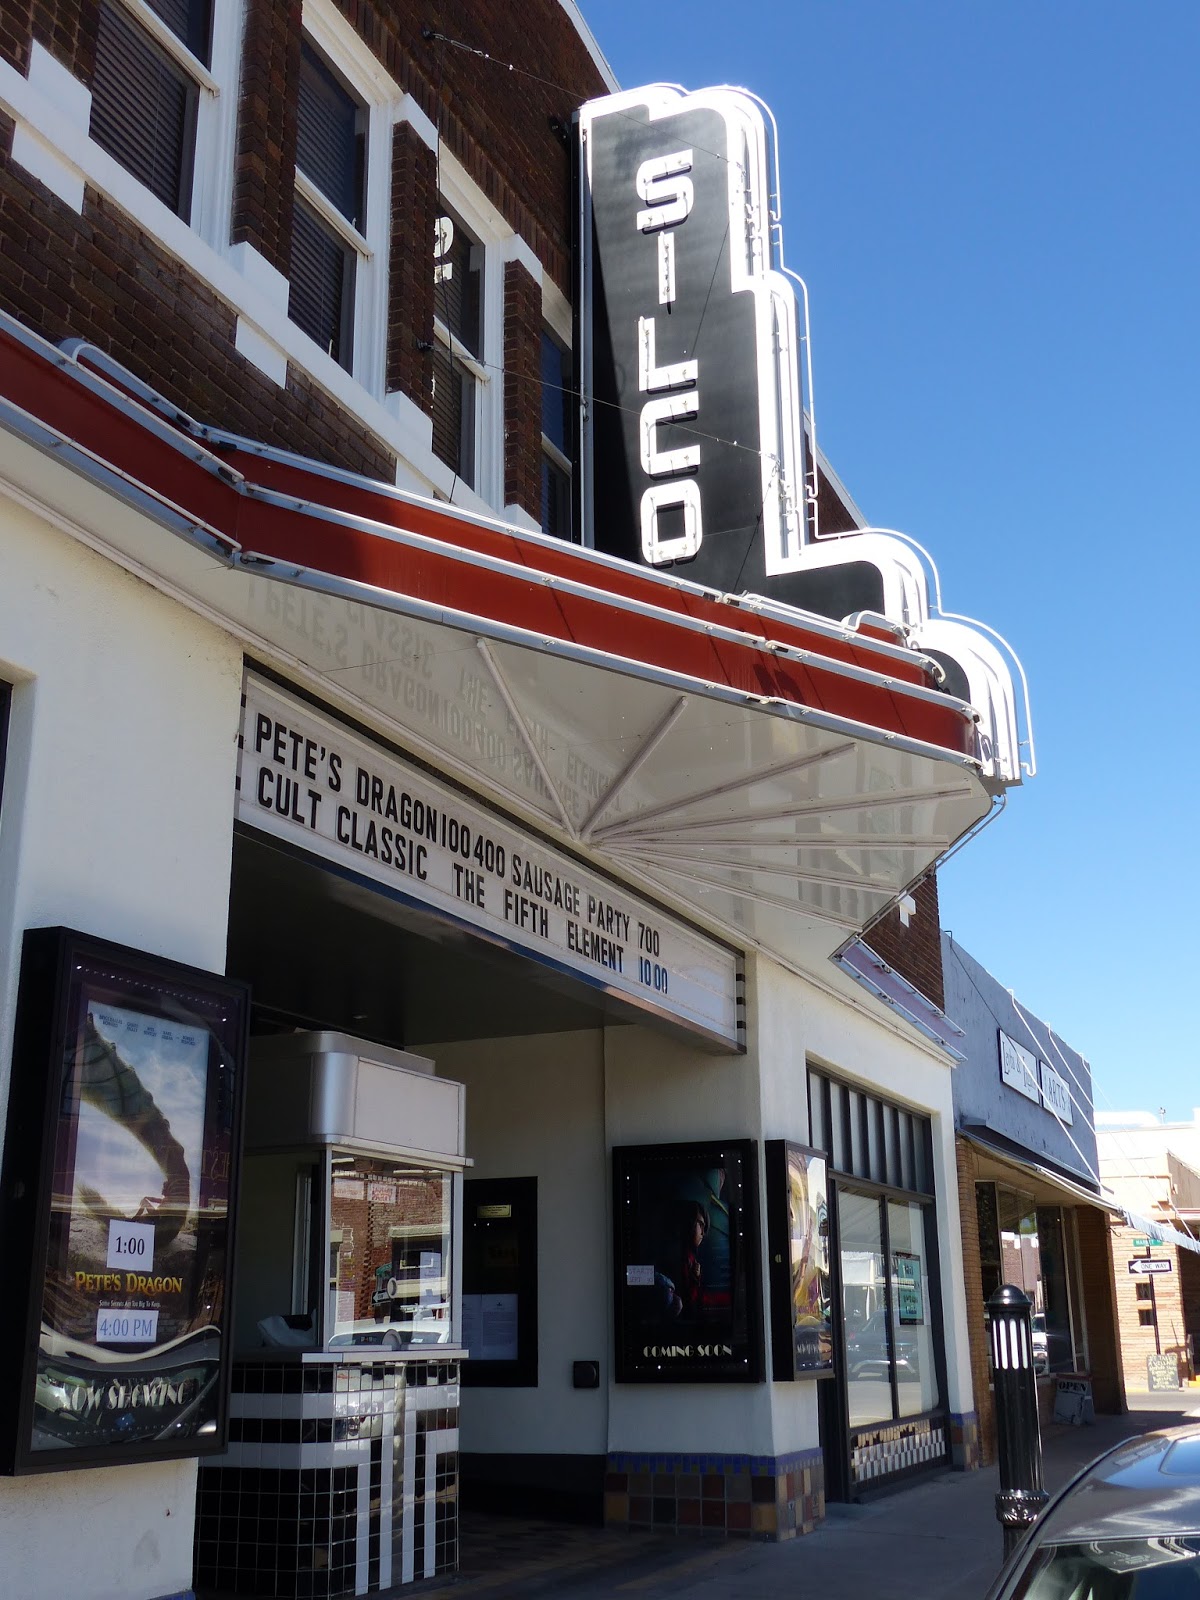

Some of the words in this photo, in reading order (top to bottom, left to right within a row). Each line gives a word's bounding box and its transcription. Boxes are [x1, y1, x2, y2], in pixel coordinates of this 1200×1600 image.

[636, 148, 703, 565] SILCO
[256, 712, 342, 792] PETE'S
[474, 834, 506, 878] 400
[512, 853, 580, 917] SAUSAGE
[588, 894, 630, 942] PARTY
[638, 921, 660, 957] 700
[257, 766, 322, 829] CULT
[337, 805, 428, 881] CLASSIC
[453, 862, 485, 909] THE
[504, 889, 549, 939] FIFTH
[567, 919, 624, 974] ELEMENT
[115, 1235, 146, 1256] 1:00
[75, 1271, 122, 1293] PETE'S
[126, 1272, 184, 1295] DRAGON
[100, 1318, 129, 1337] 4:00
[133, 1319, 153, 1337] PM
[643, 1345, 695, 1358] COMING
[697, 1344, 732, 1358] SOON
[1059, 1381, 1087, 1391] OPEN
